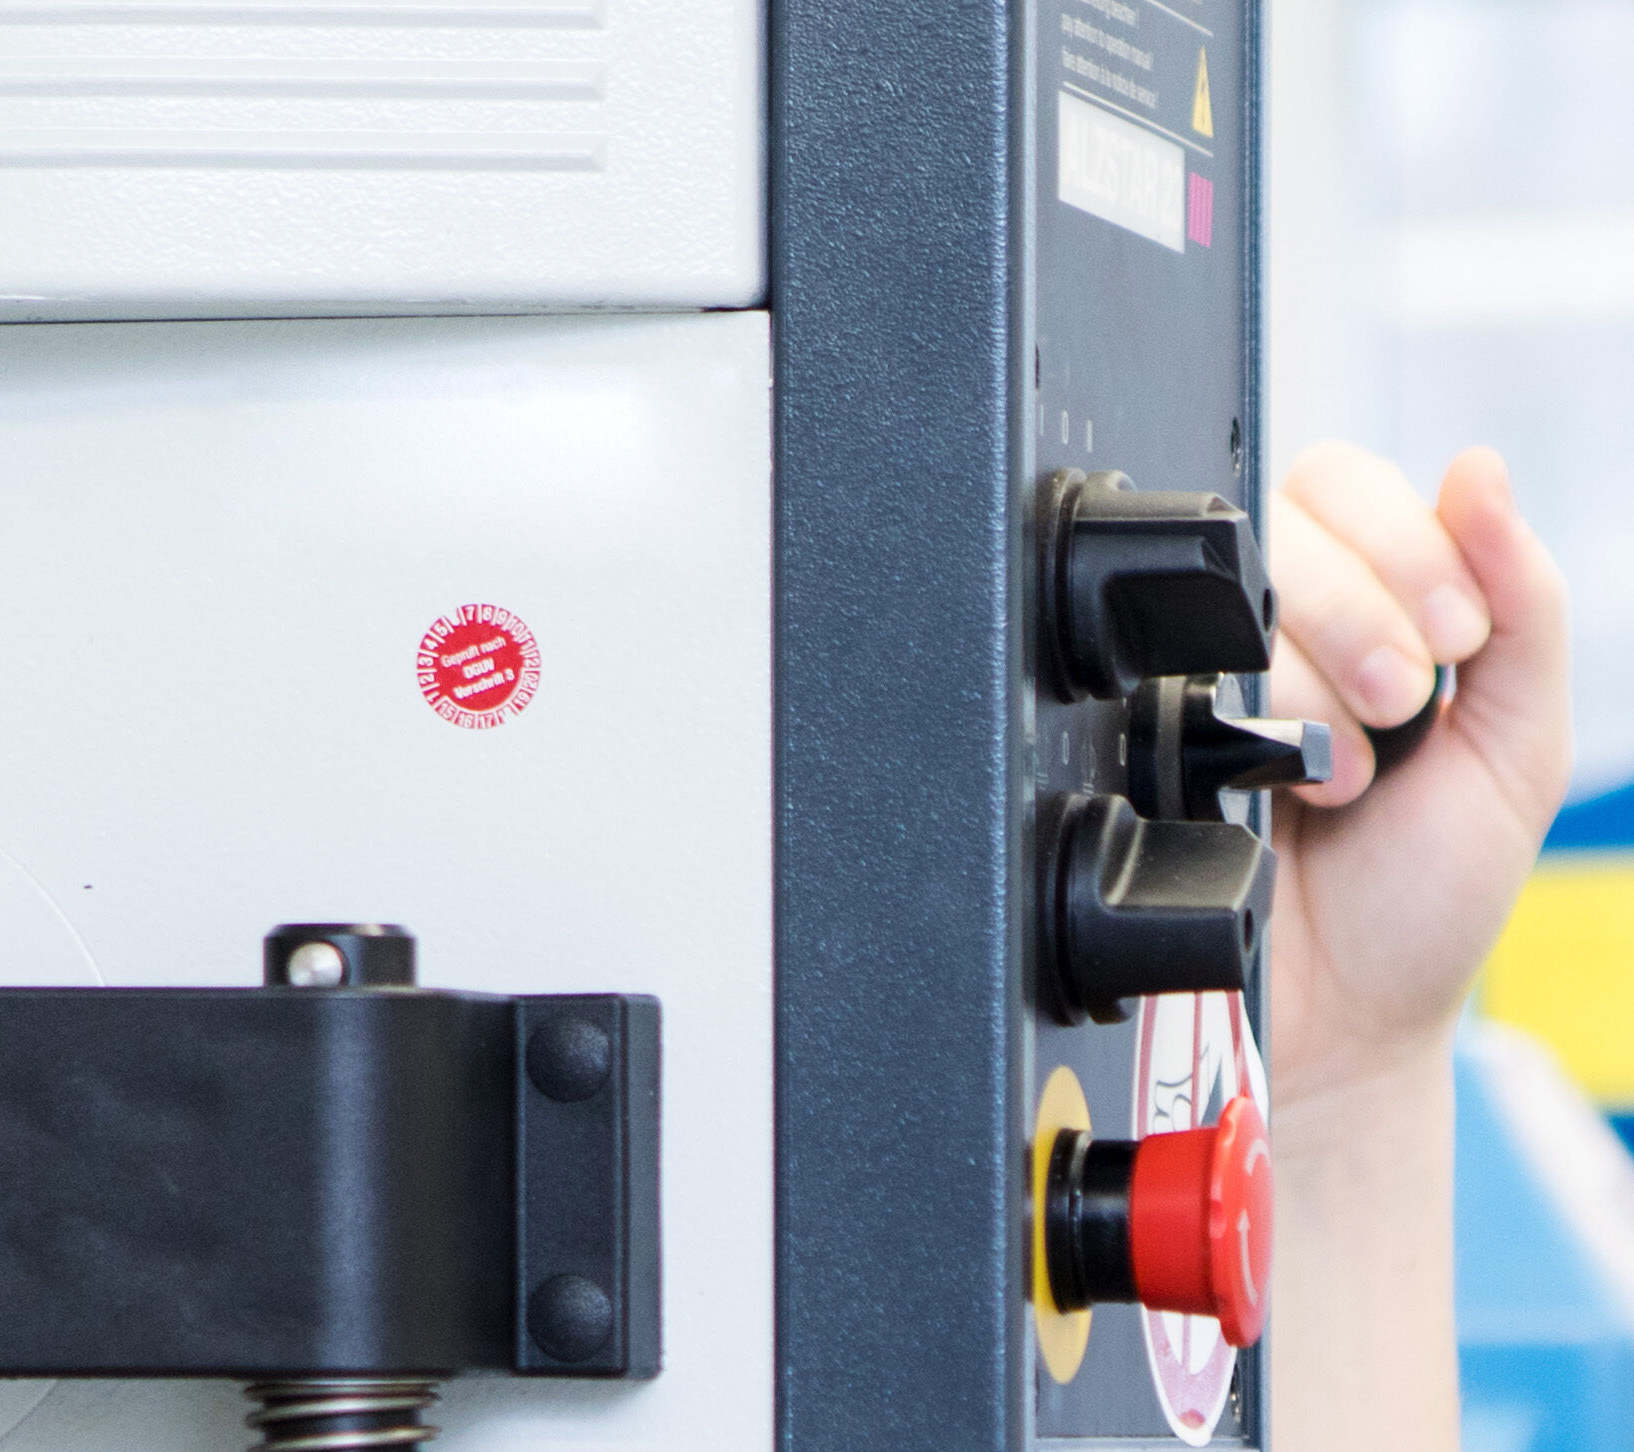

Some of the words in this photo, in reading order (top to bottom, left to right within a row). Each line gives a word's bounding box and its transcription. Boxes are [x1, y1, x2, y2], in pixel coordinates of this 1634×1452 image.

[465, 606, 475, 621] 7
[483, 606, 492, 621] 8
[434, 623, 447, 636] 5
[424, 639, 438, 650] 4
[481, 636, 506, 654] nach
[418, 656, 433, 666] 3
[420, 675, 434, 684] 2
[453, 671, 505, 699] Vorschrift
[505, 668, 514, 681] 3
